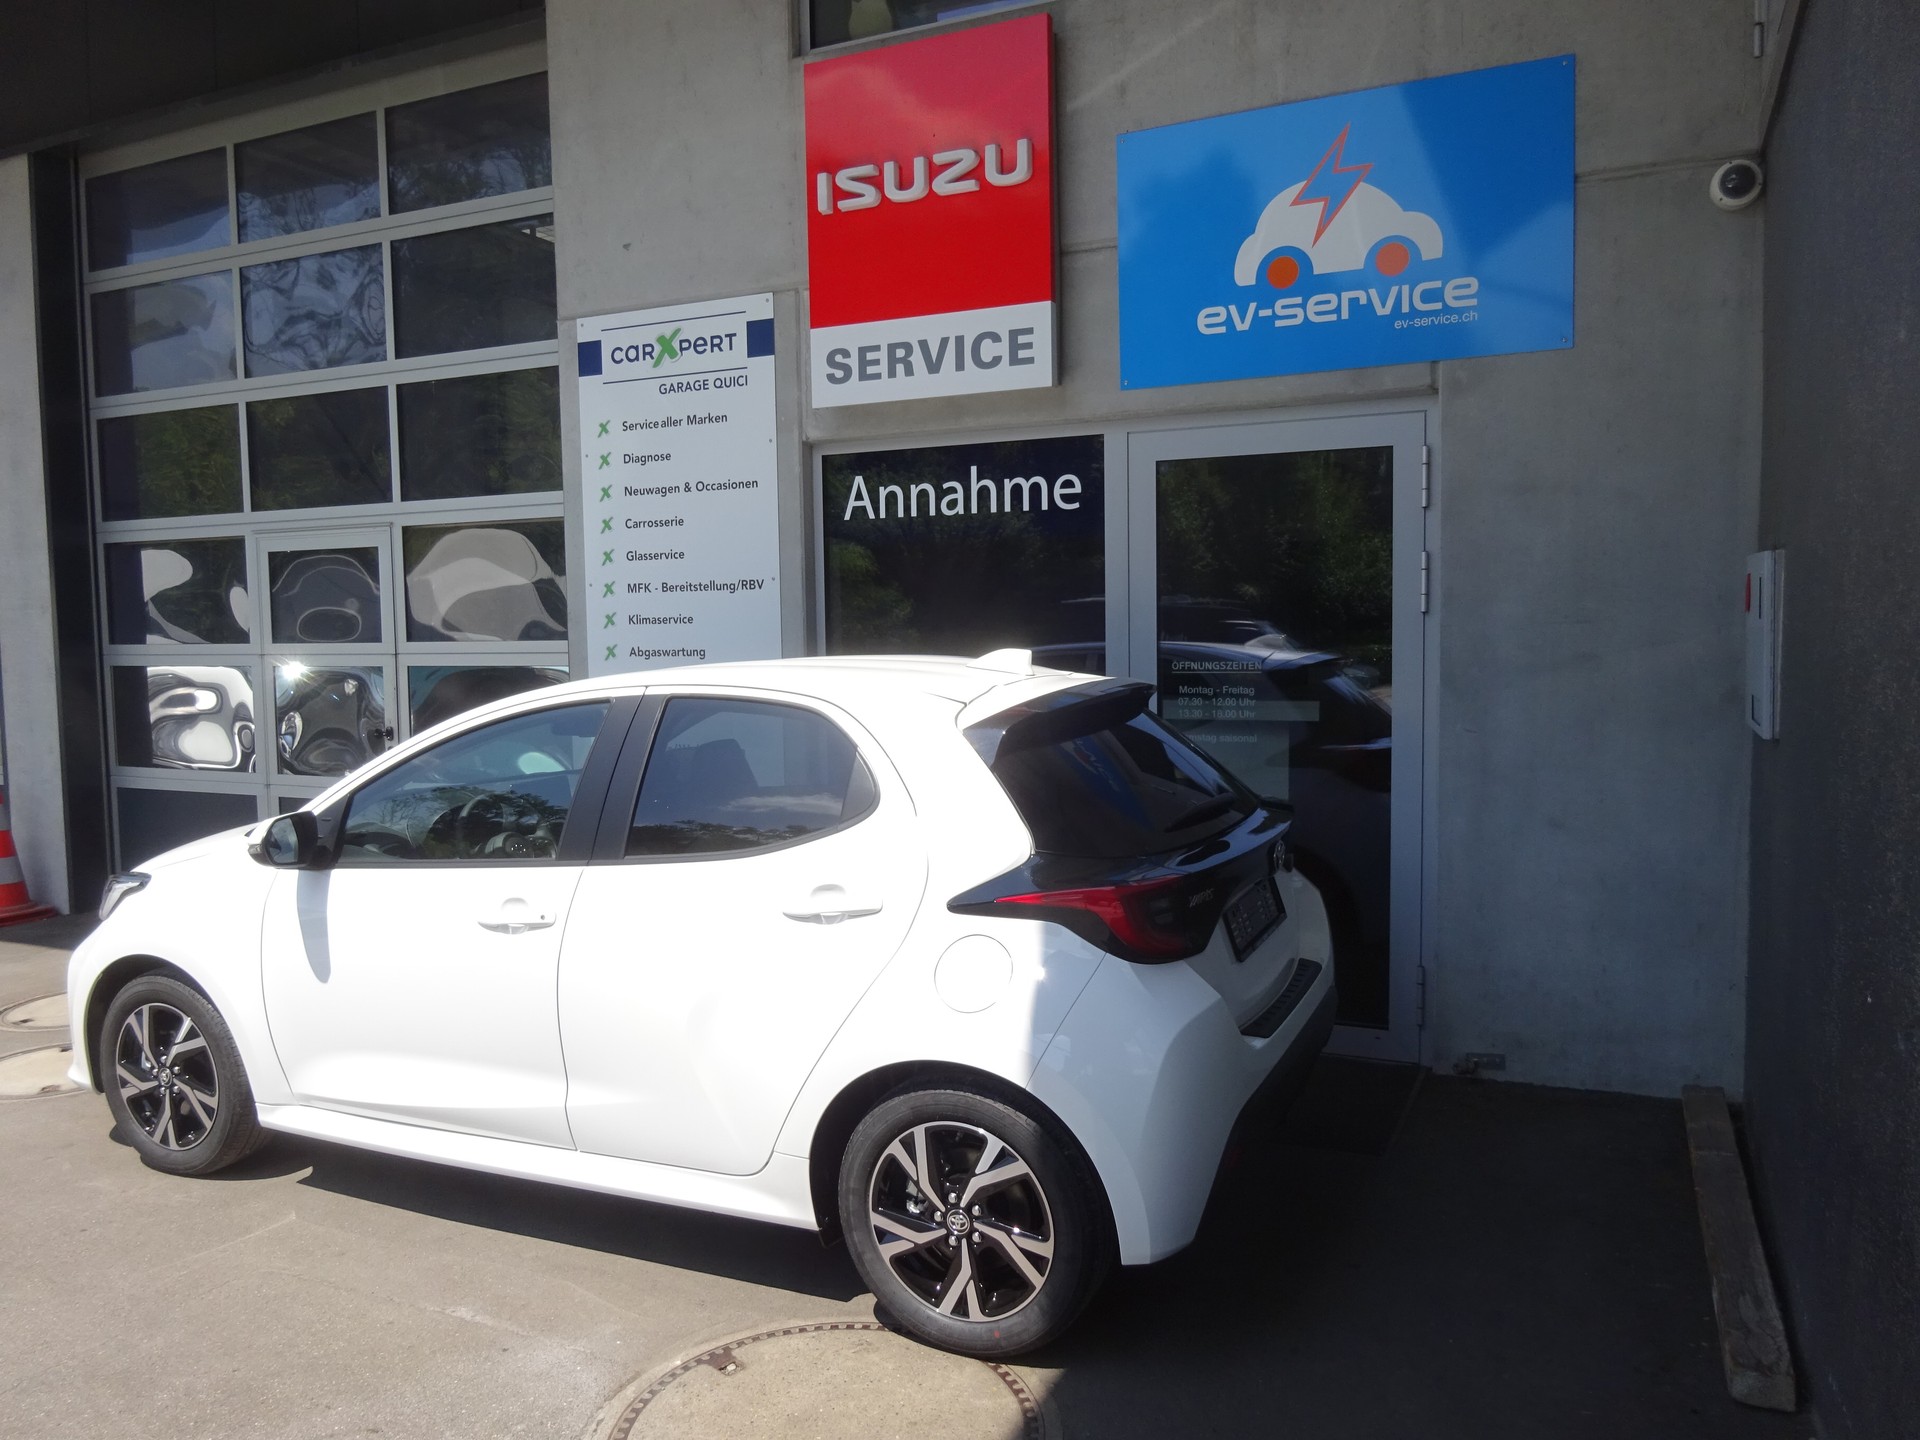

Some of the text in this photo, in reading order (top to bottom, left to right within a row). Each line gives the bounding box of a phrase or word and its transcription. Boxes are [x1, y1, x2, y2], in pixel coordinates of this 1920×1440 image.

[816, 138, 1033, 215] ISUZU
[1197, 276, 1479, 335] ev-service
[1394, 310, 1478, 329] ev-service.ch
[825, 326, 1035, 385] SERVICE
[658, 375, 748, 395] GARAGE QUICI
[622, 412, 728, 432] Service aller Marken
[623, 452, 672, 466] Diagnose
[624, 479, 759, 497] Neuwagen & Occasionen
[843, 465, 1082, 521] Annahme
[625, 517, 685, 529] Carrosserie
[626, 550, 685, 562] Glasservice
[627, 583, 652, 594] MFK
[661, 579, 765, 594] Bereitstellung/RBV
[628, 614, 694, 625] Klimaservice
[629, 646, 706, 660] Abgaswartung
[1178, 686, 1213, 695] Montag
[1222, 685, 1255, 695] Freitag
[1239, 698, 1256, 706] Uhr
[1239, 709, 1256, 718] Uhr
[1219, 734, 1257, 743] saisonal
